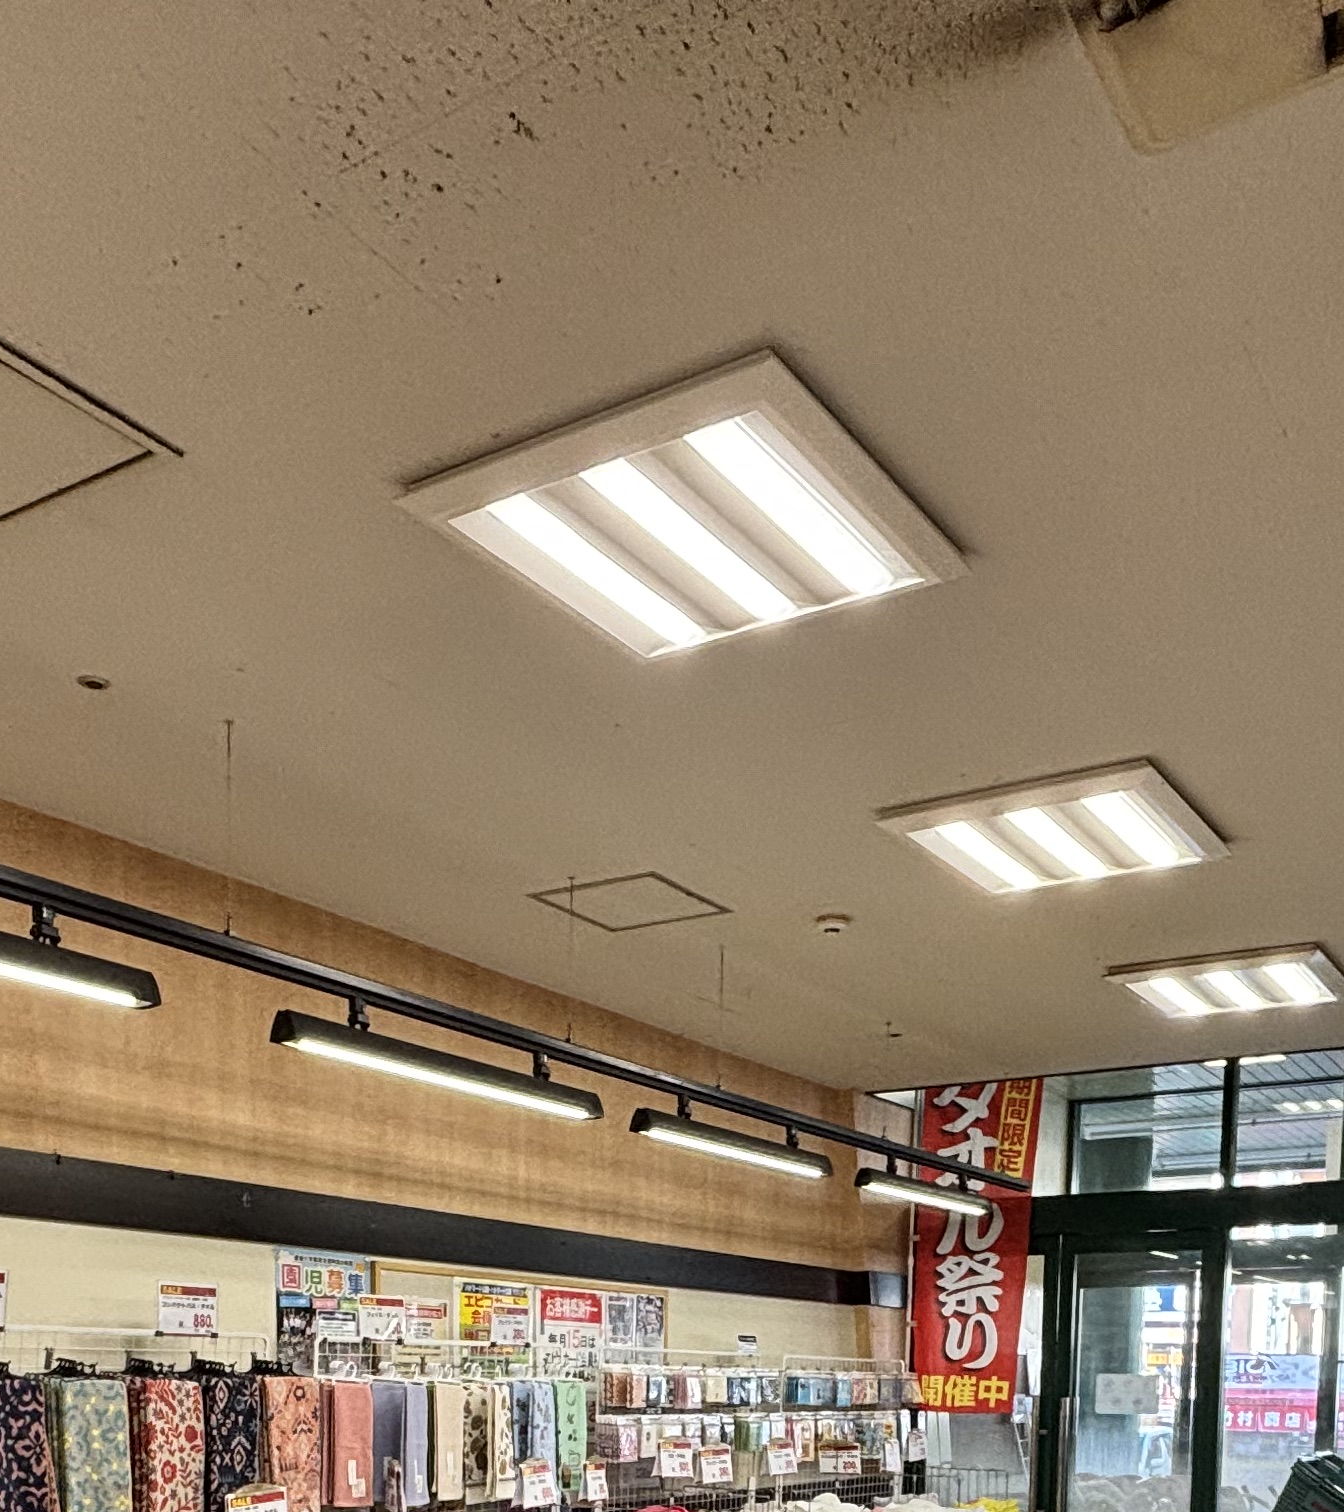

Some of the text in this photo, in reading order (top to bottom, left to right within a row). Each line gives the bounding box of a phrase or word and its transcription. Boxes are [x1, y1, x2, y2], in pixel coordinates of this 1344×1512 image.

[162, 1285, 183, 1295] SALE
[281, 1263, 365, 1297] 園児募集
[920, 1375, 1010, 1408] 開催中
[232, 1497, 253, 1507] SALE
